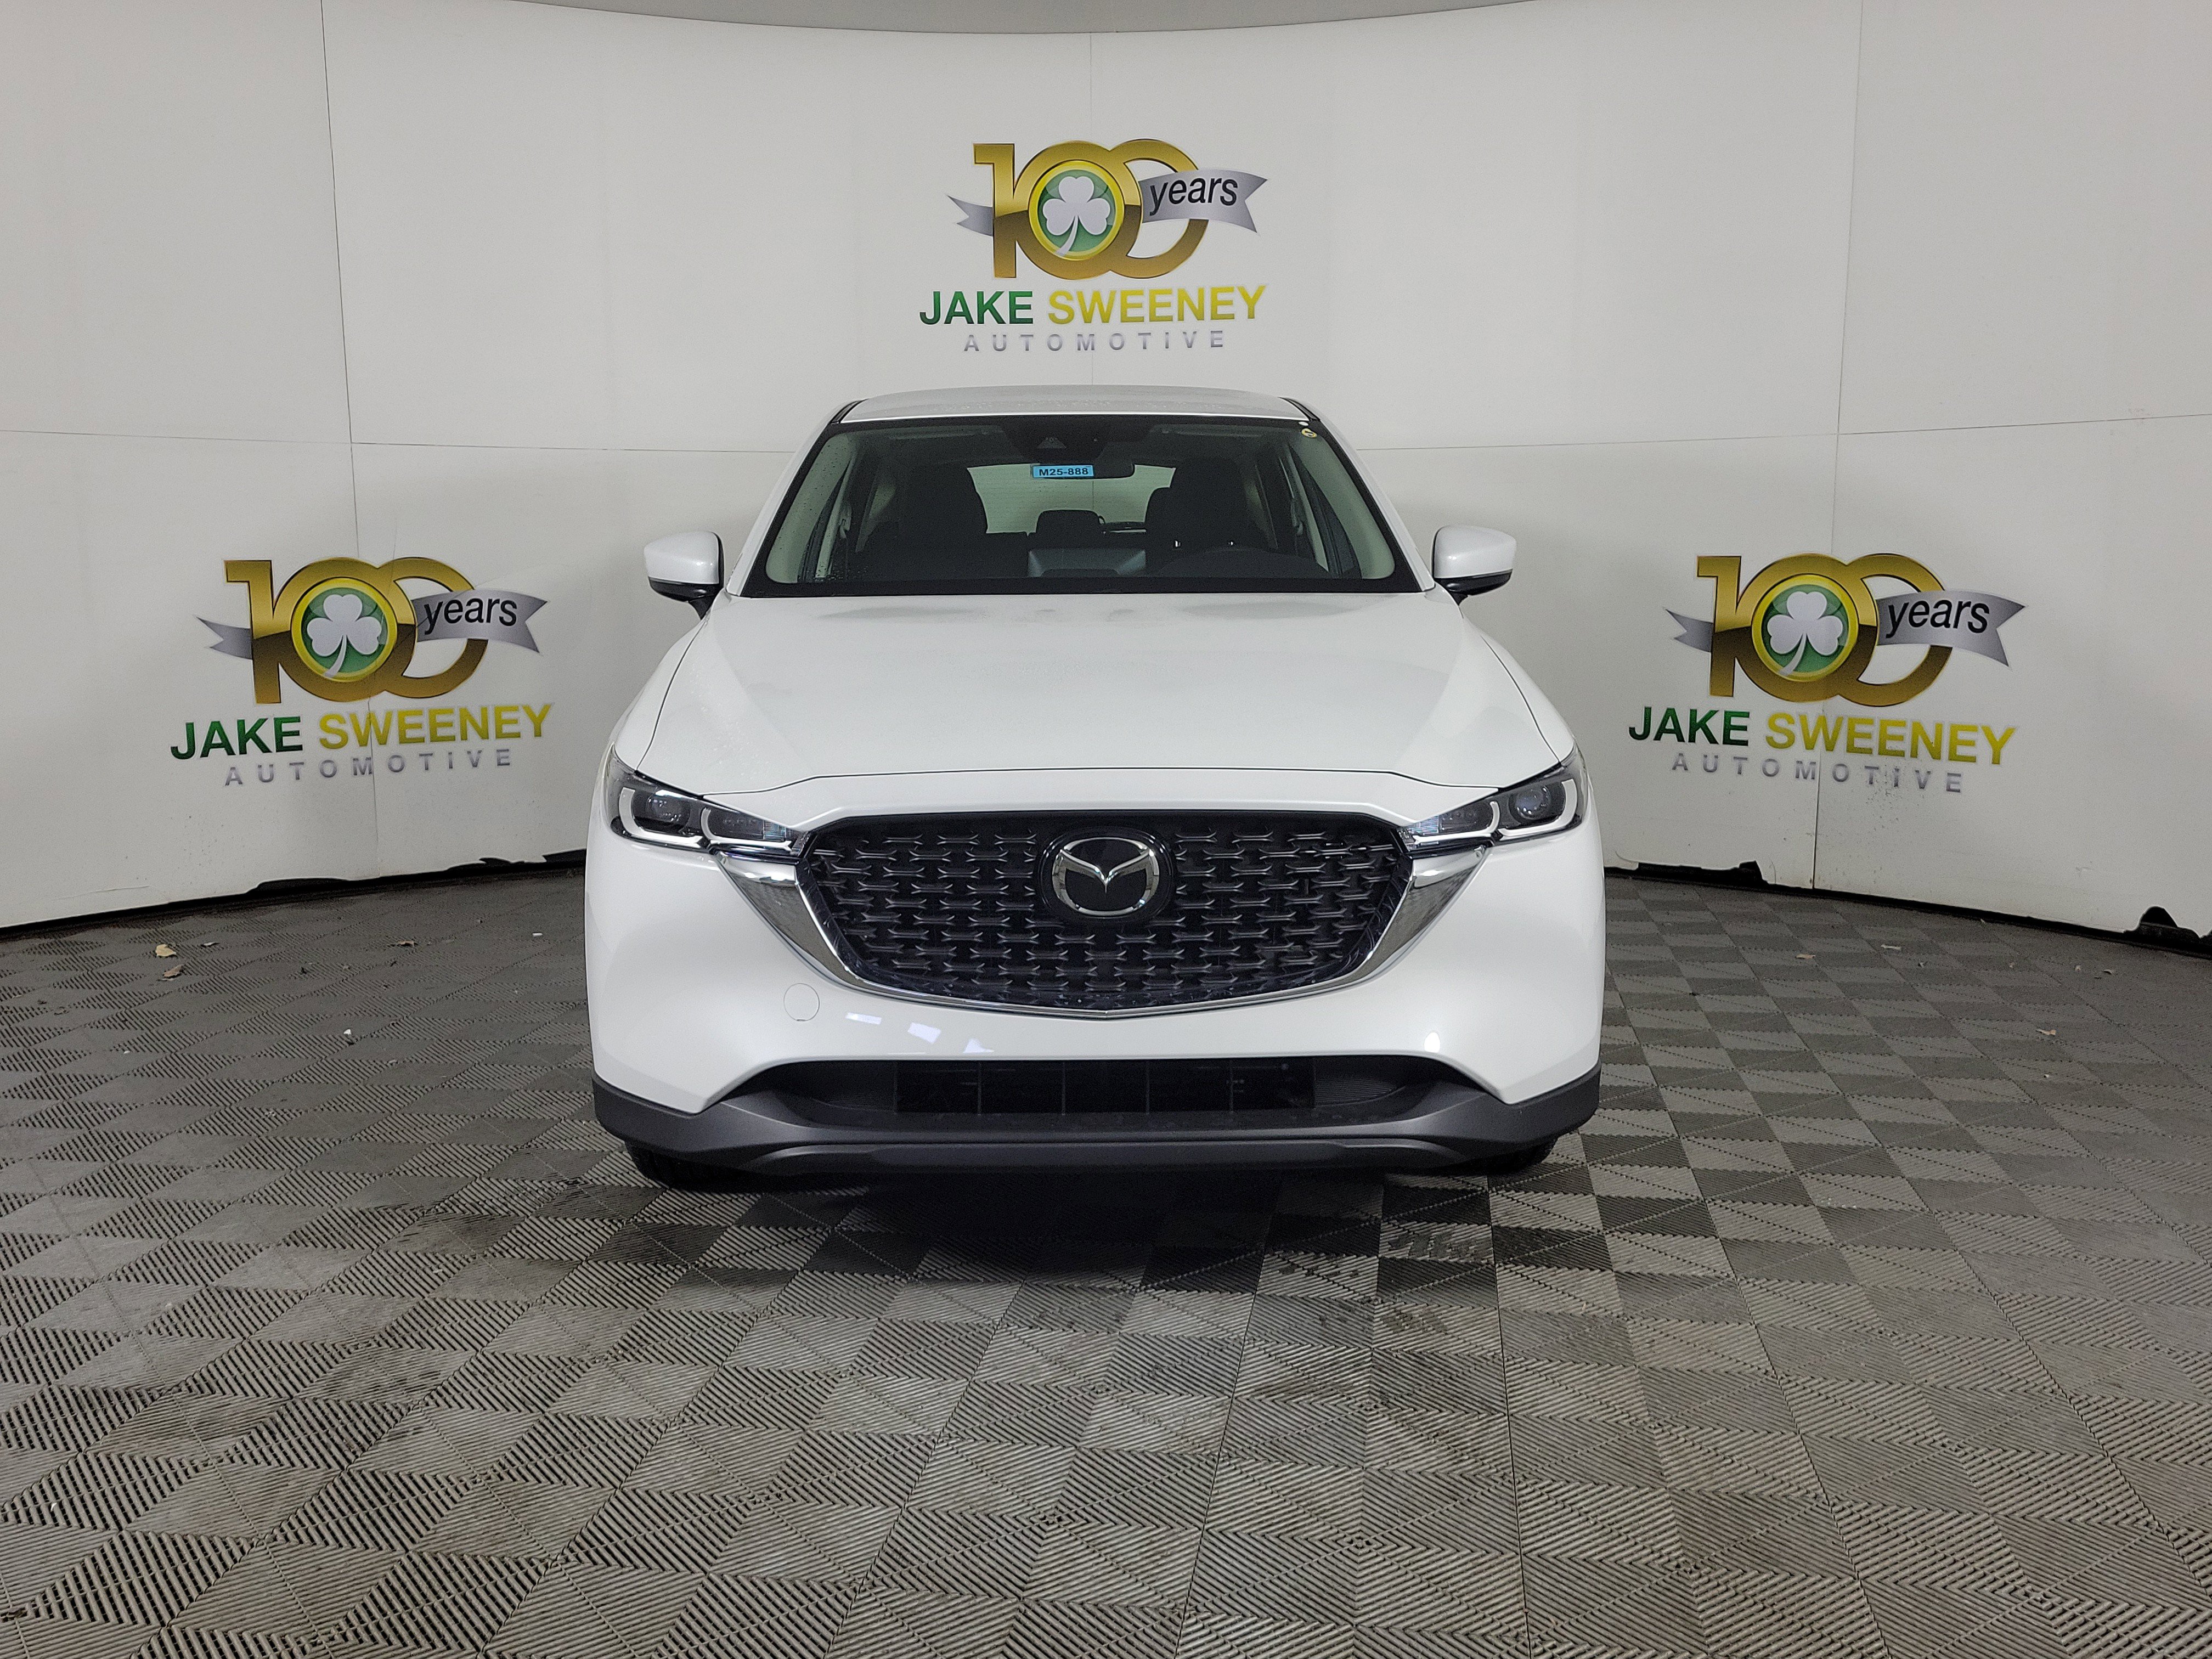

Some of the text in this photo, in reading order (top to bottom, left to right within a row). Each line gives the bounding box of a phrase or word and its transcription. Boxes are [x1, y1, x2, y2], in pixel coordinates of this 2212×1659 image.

[972, 138, 1239, 281] 100 years
[919, 285, 1266, 325] JAKE SWEENEY
[964, 330, 1224, 351] AUTOMOTIVE
[1039, 467, 1088, 476] M25-888
[223, 557, 518, 704] 100 years
[1697, 553, 1991, 707] 100 years
[170, 704, 552, 760] JAKE SWEENEY
[1628, 707, 2016, 765] JAKE SWEENEY
[224, 749, 511, 787] AUTOMOTIVE
[1671, 753, 1962, 793] AUTOMOTIVE
